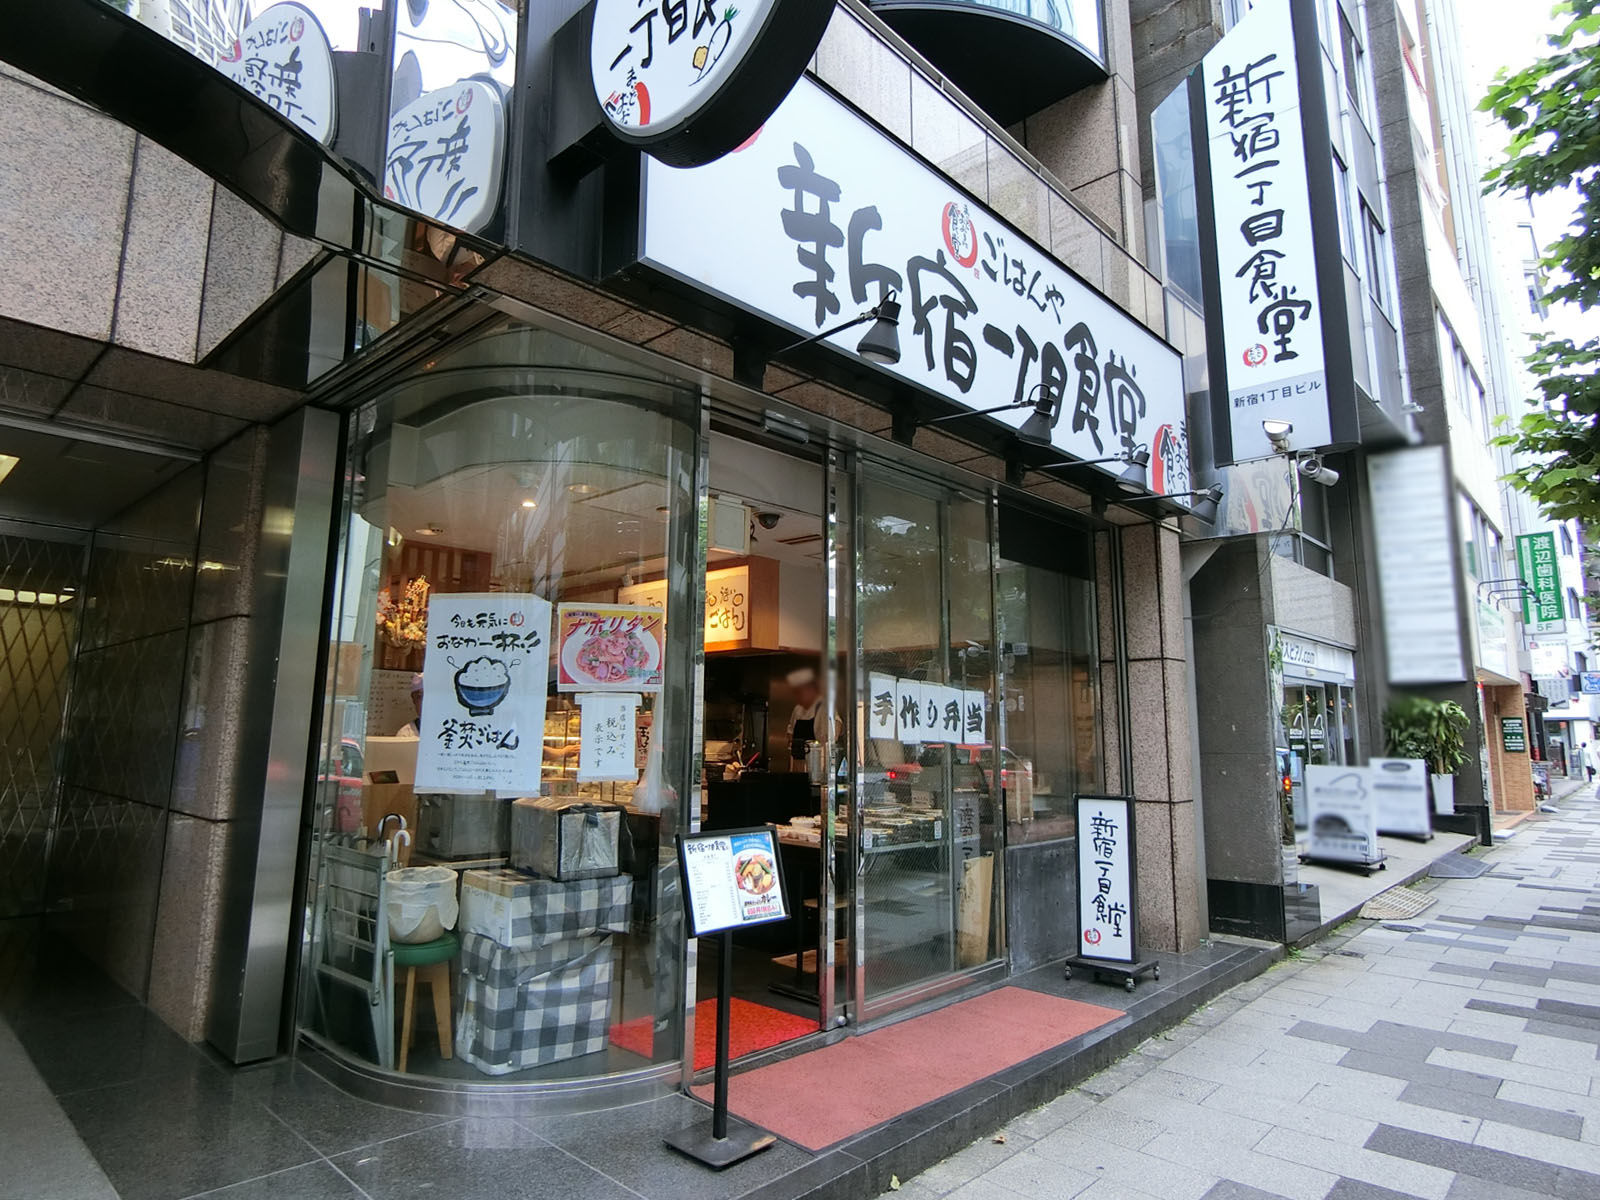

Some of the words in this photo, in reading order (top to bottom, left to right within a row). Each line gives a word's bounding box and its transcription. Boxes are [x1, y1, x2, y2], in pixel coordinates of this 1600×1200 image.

[1213, 53, 1312, 363] 新宿一丁目食堂
[777, 141, 1146, 458] 新宿一丁目食堂
[981, 231, 1065, 325] ごはんや
[1233, 380, 1321, 408] 新宿1丁目ビル
[451, 612, 509, 629] 今日も元気に
[566, 615, 661, 637] ナポリタン
[1536, 623, 1553, 632] 5F
[872, 690, 984, 733] 手作り弁当
[594, 723, 604, 767] 表示です
[606, 717, 618, 754] 税込み
[1090, 811, 1127, 938] 新宿一丁目食堂
